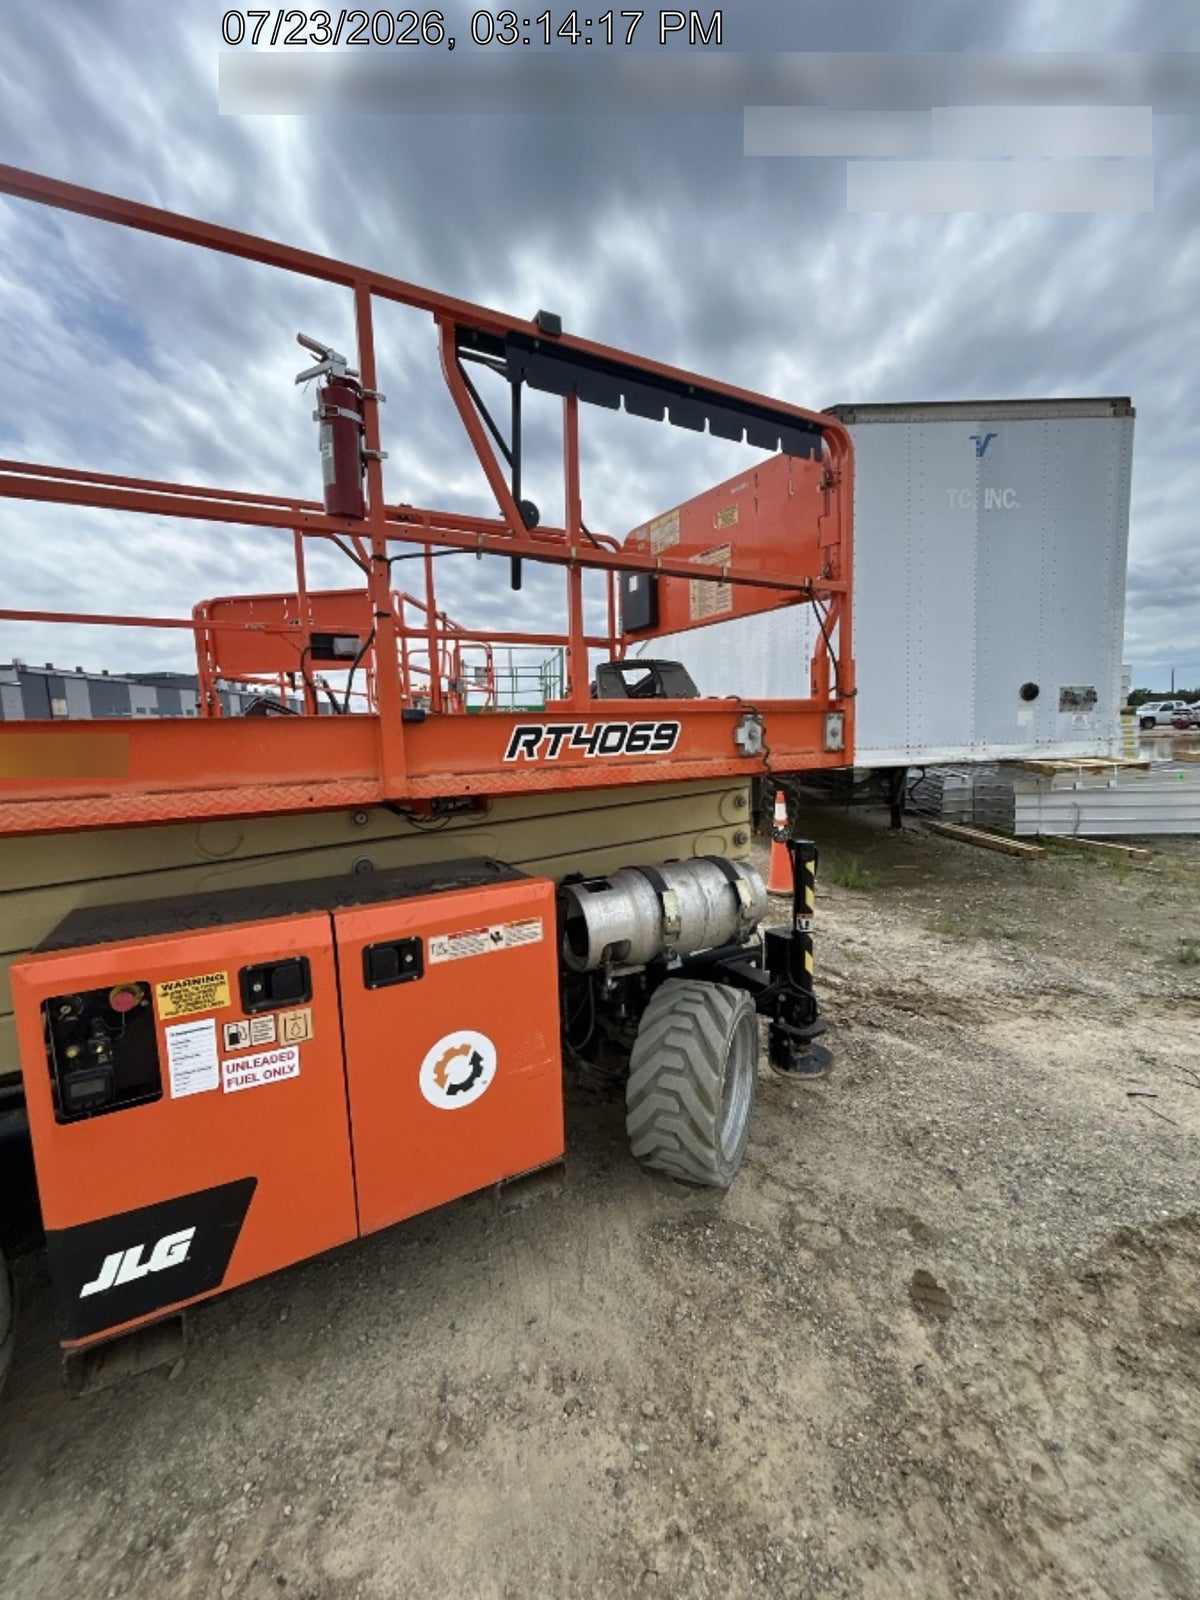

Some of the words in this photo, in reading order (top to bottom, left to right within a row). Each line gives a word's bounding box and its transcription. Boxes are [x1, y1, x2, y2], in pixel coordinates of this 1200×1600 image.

[984, 488, 1021, 510] INC.
[503, 720, 682, 762] RT4069
[161, 973, 225, 991] WARNING
[226, 1050, 296, 1075] UNLEADED
[227, 1072, 261, 1090] FUEL
[263, 1064, 296, 1080] ONLY
[79, 1226, 197, 1299] JLG
